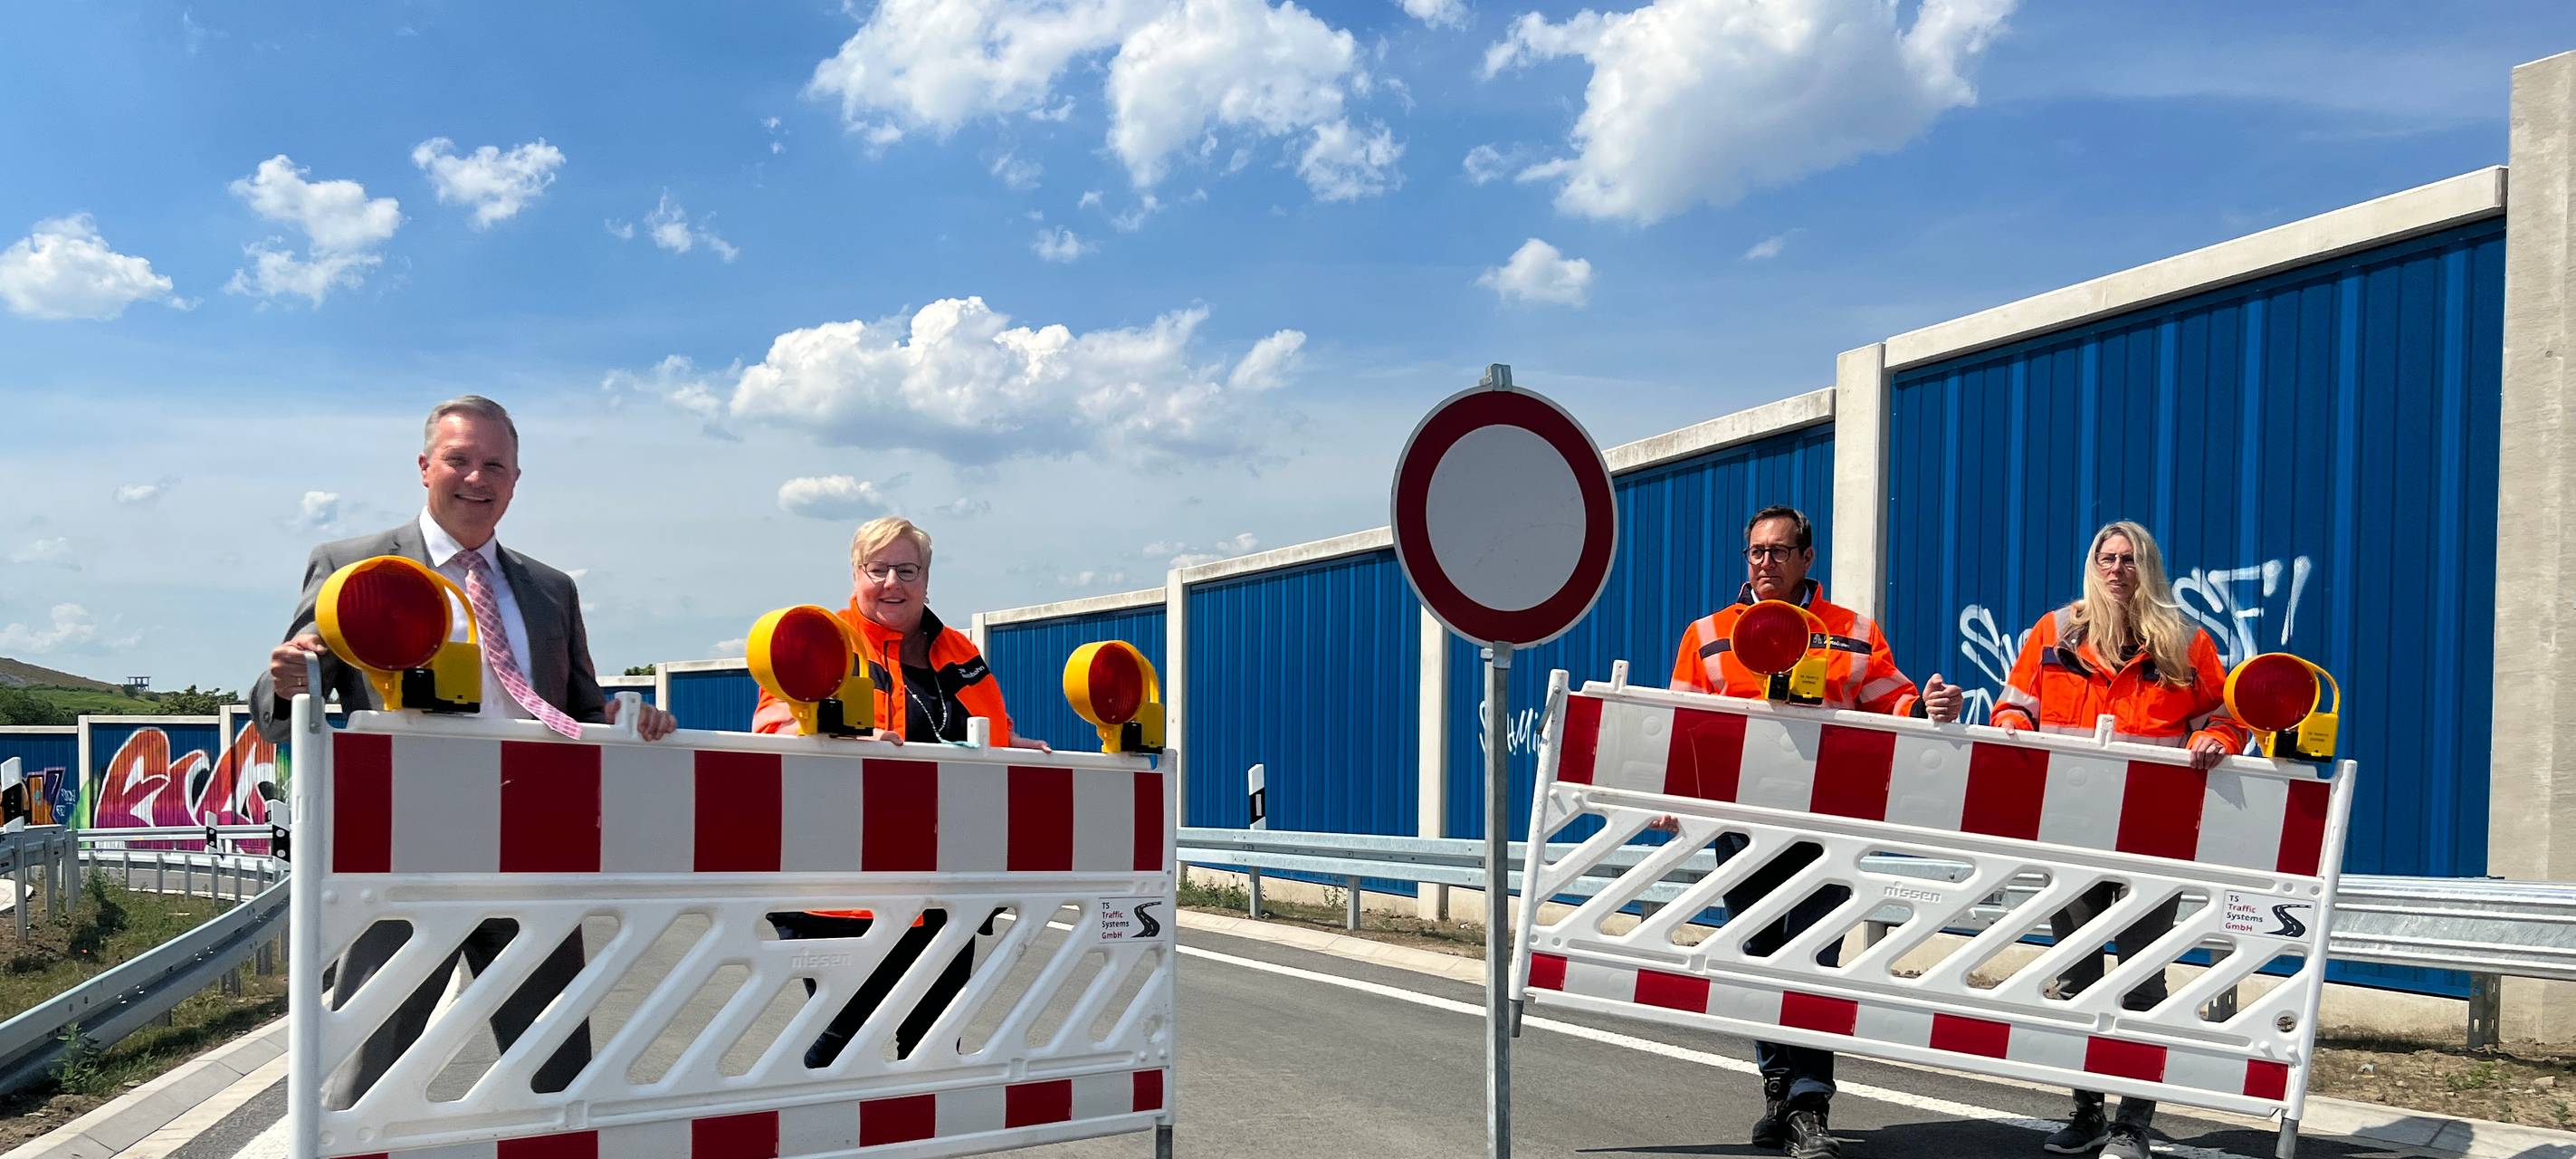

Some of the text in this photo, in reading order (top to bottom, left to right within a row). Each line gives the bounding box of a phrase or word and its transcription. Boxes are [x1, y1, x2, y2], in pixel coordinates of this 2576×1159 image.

[1884, 881, 1942, 904] nissen
[2228, 904, 2256, 914] Traffic
[1102, 911, 1123, 919] Traffic
[2227, 912, 2263, 923] Systems
[1102, 920, 1130, 929] Systems
[2225, 923, 2253, 932] GmbH
[1102, 932, 1122, 940] GmbH
